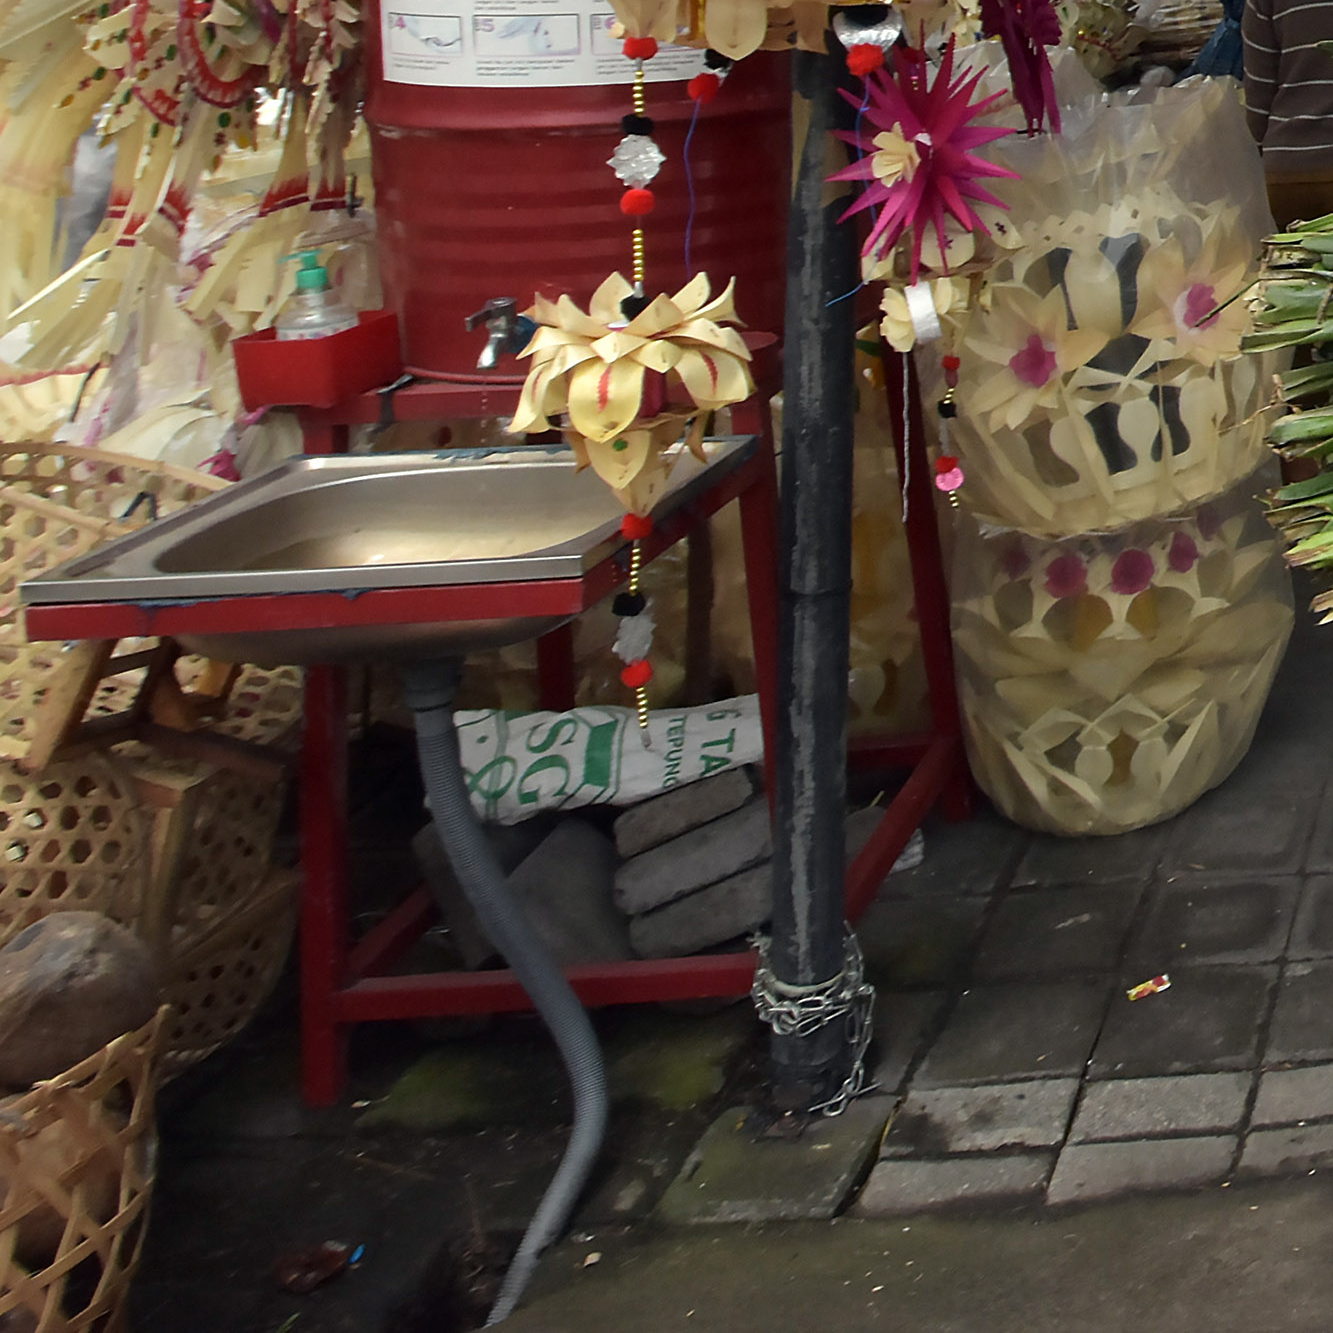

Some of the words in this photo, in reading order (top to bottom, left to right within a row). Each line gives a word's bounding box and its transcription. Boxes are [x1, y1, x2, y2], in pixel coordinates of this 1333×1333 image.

[482, 18, 495, 32] 5
[518, 717, 580, 805] SG
[663, 714, 690, 788] TEPUNG
